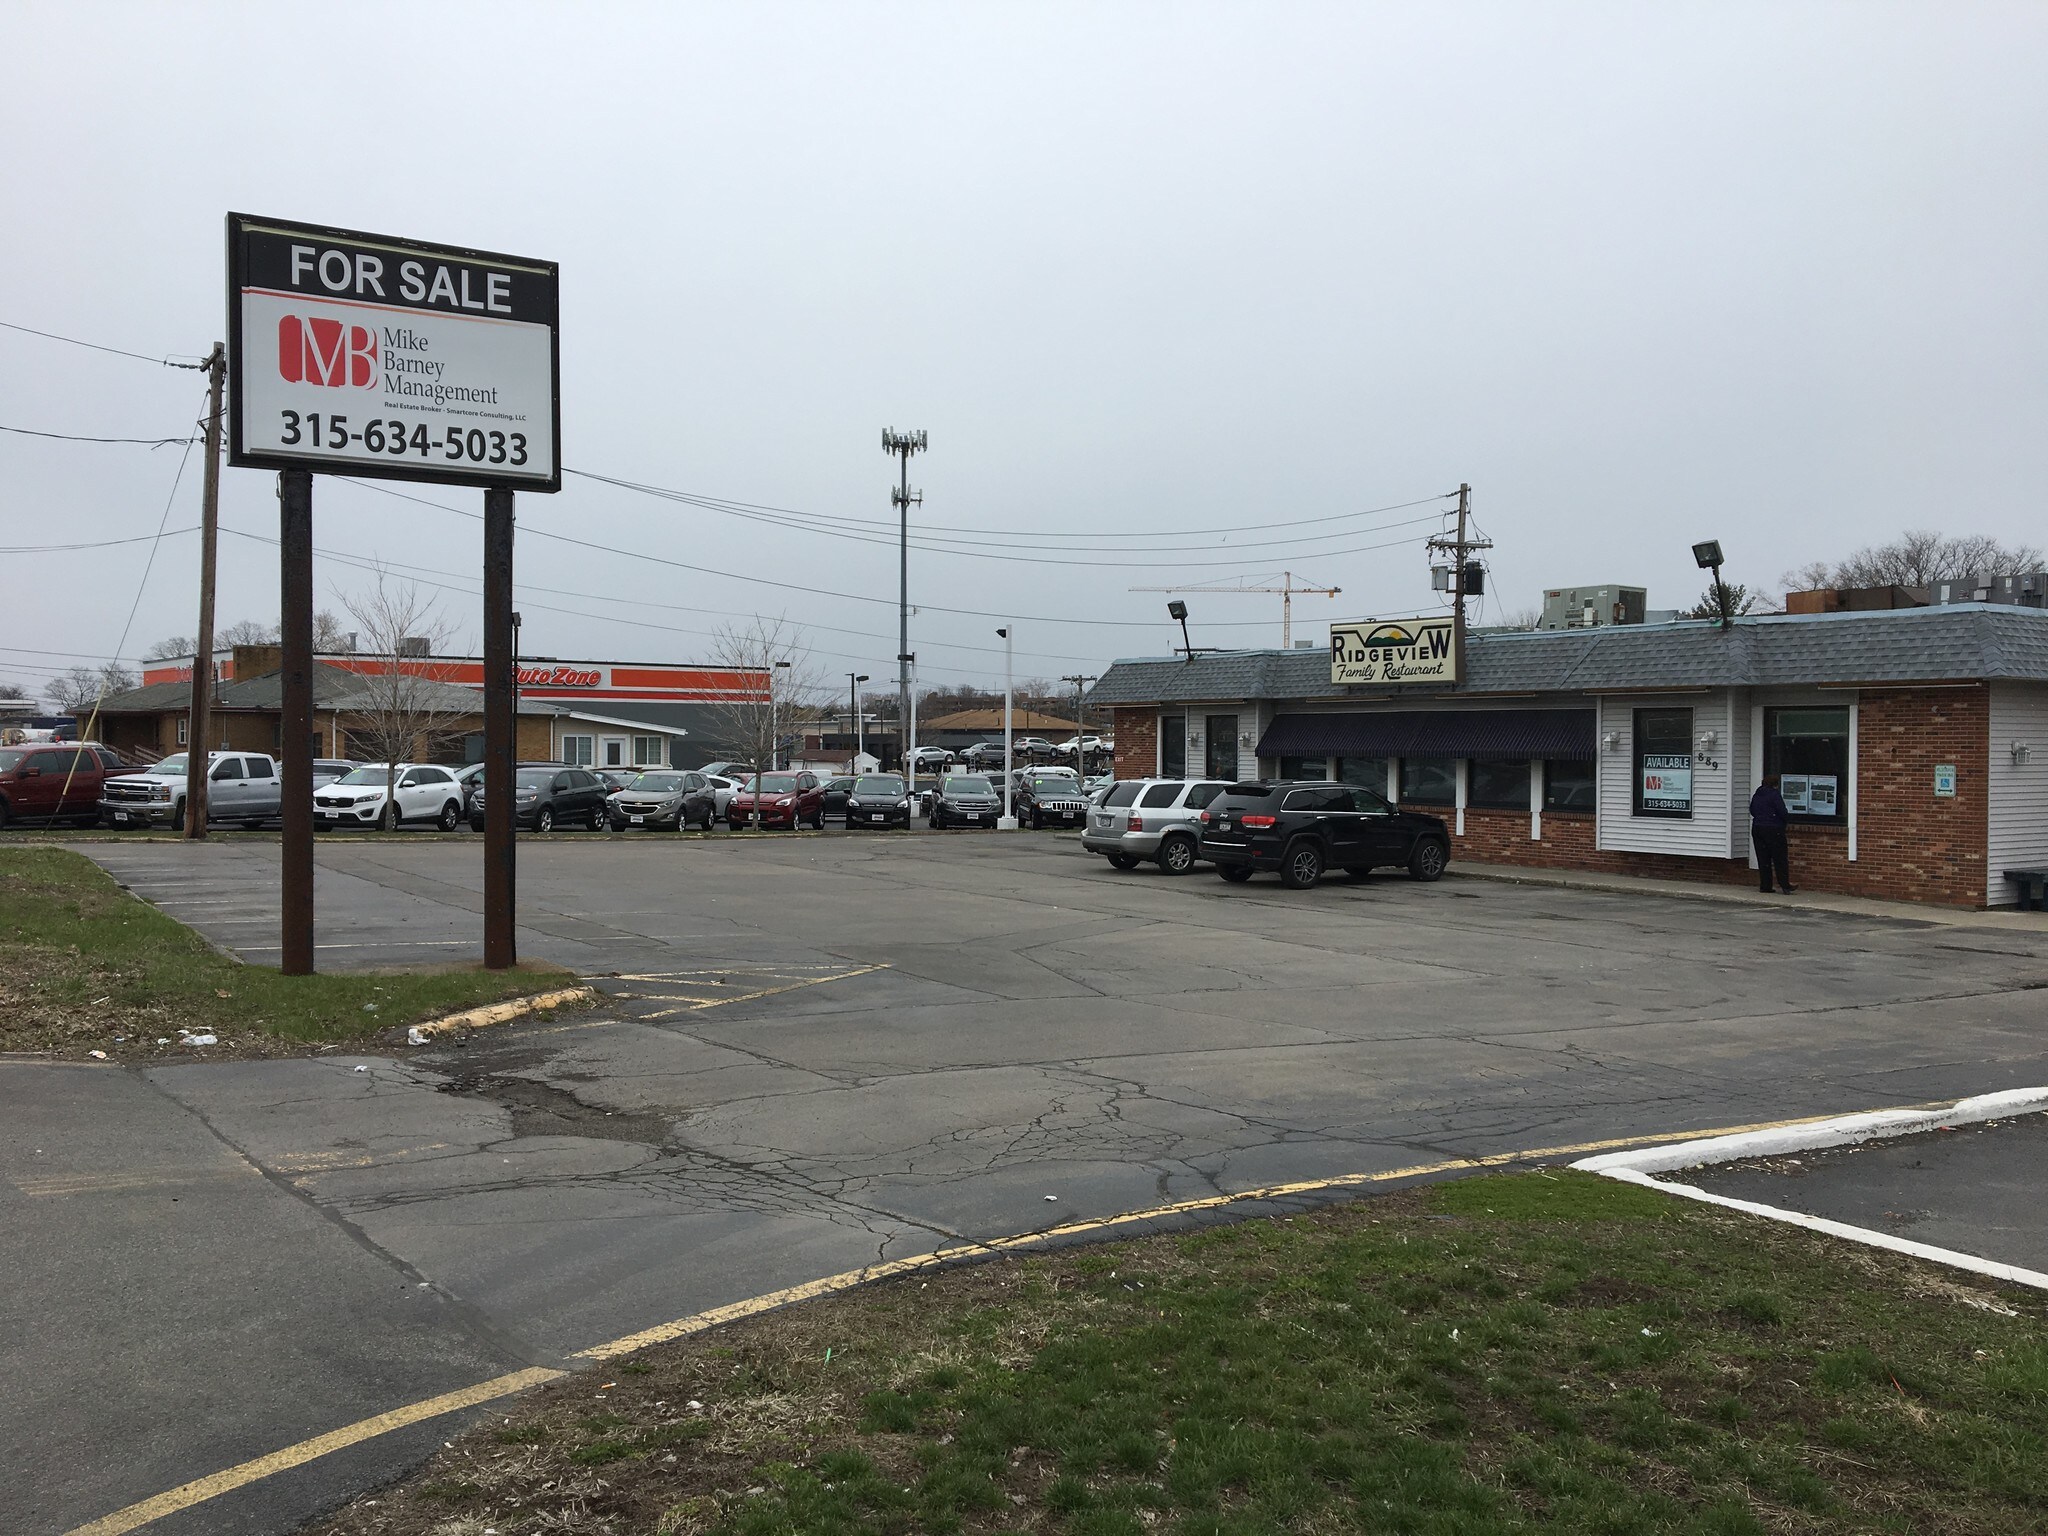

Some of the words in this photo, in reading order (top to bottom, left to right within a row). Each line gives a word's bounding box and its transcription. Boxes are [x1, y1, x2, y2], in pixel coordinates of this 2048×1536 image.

[290, 244, 387, 297] FOR
[399, 260, 512, 313] SALE
[383, 326, 429, 352] Mike
[383, 350, 445, 382] Barney
[383, 373, 498, 405] Management
[384, 401, 399, 409] Real
[399, 403, 420, 411] Estate
[420, 405, 442, 413] Broker
[446, 407, 479, 417] Smartcore
[479, 411, 515, 421] Consulting,
[515, 414, 527, 422] LLC
[280, 409, 529, 466] 315-634-5033
[1332, 629, 1452, 663] RIDGEVIEW
[1336, 664, 1377, 681] Family
[1381, 662, 1444, 680] Restaurant
[1646, 757, 1689, 769] AVAILABLE
[1697, 752, 1719, 771] 889
[1647, 799, 1687, 809] 315-634-5033
